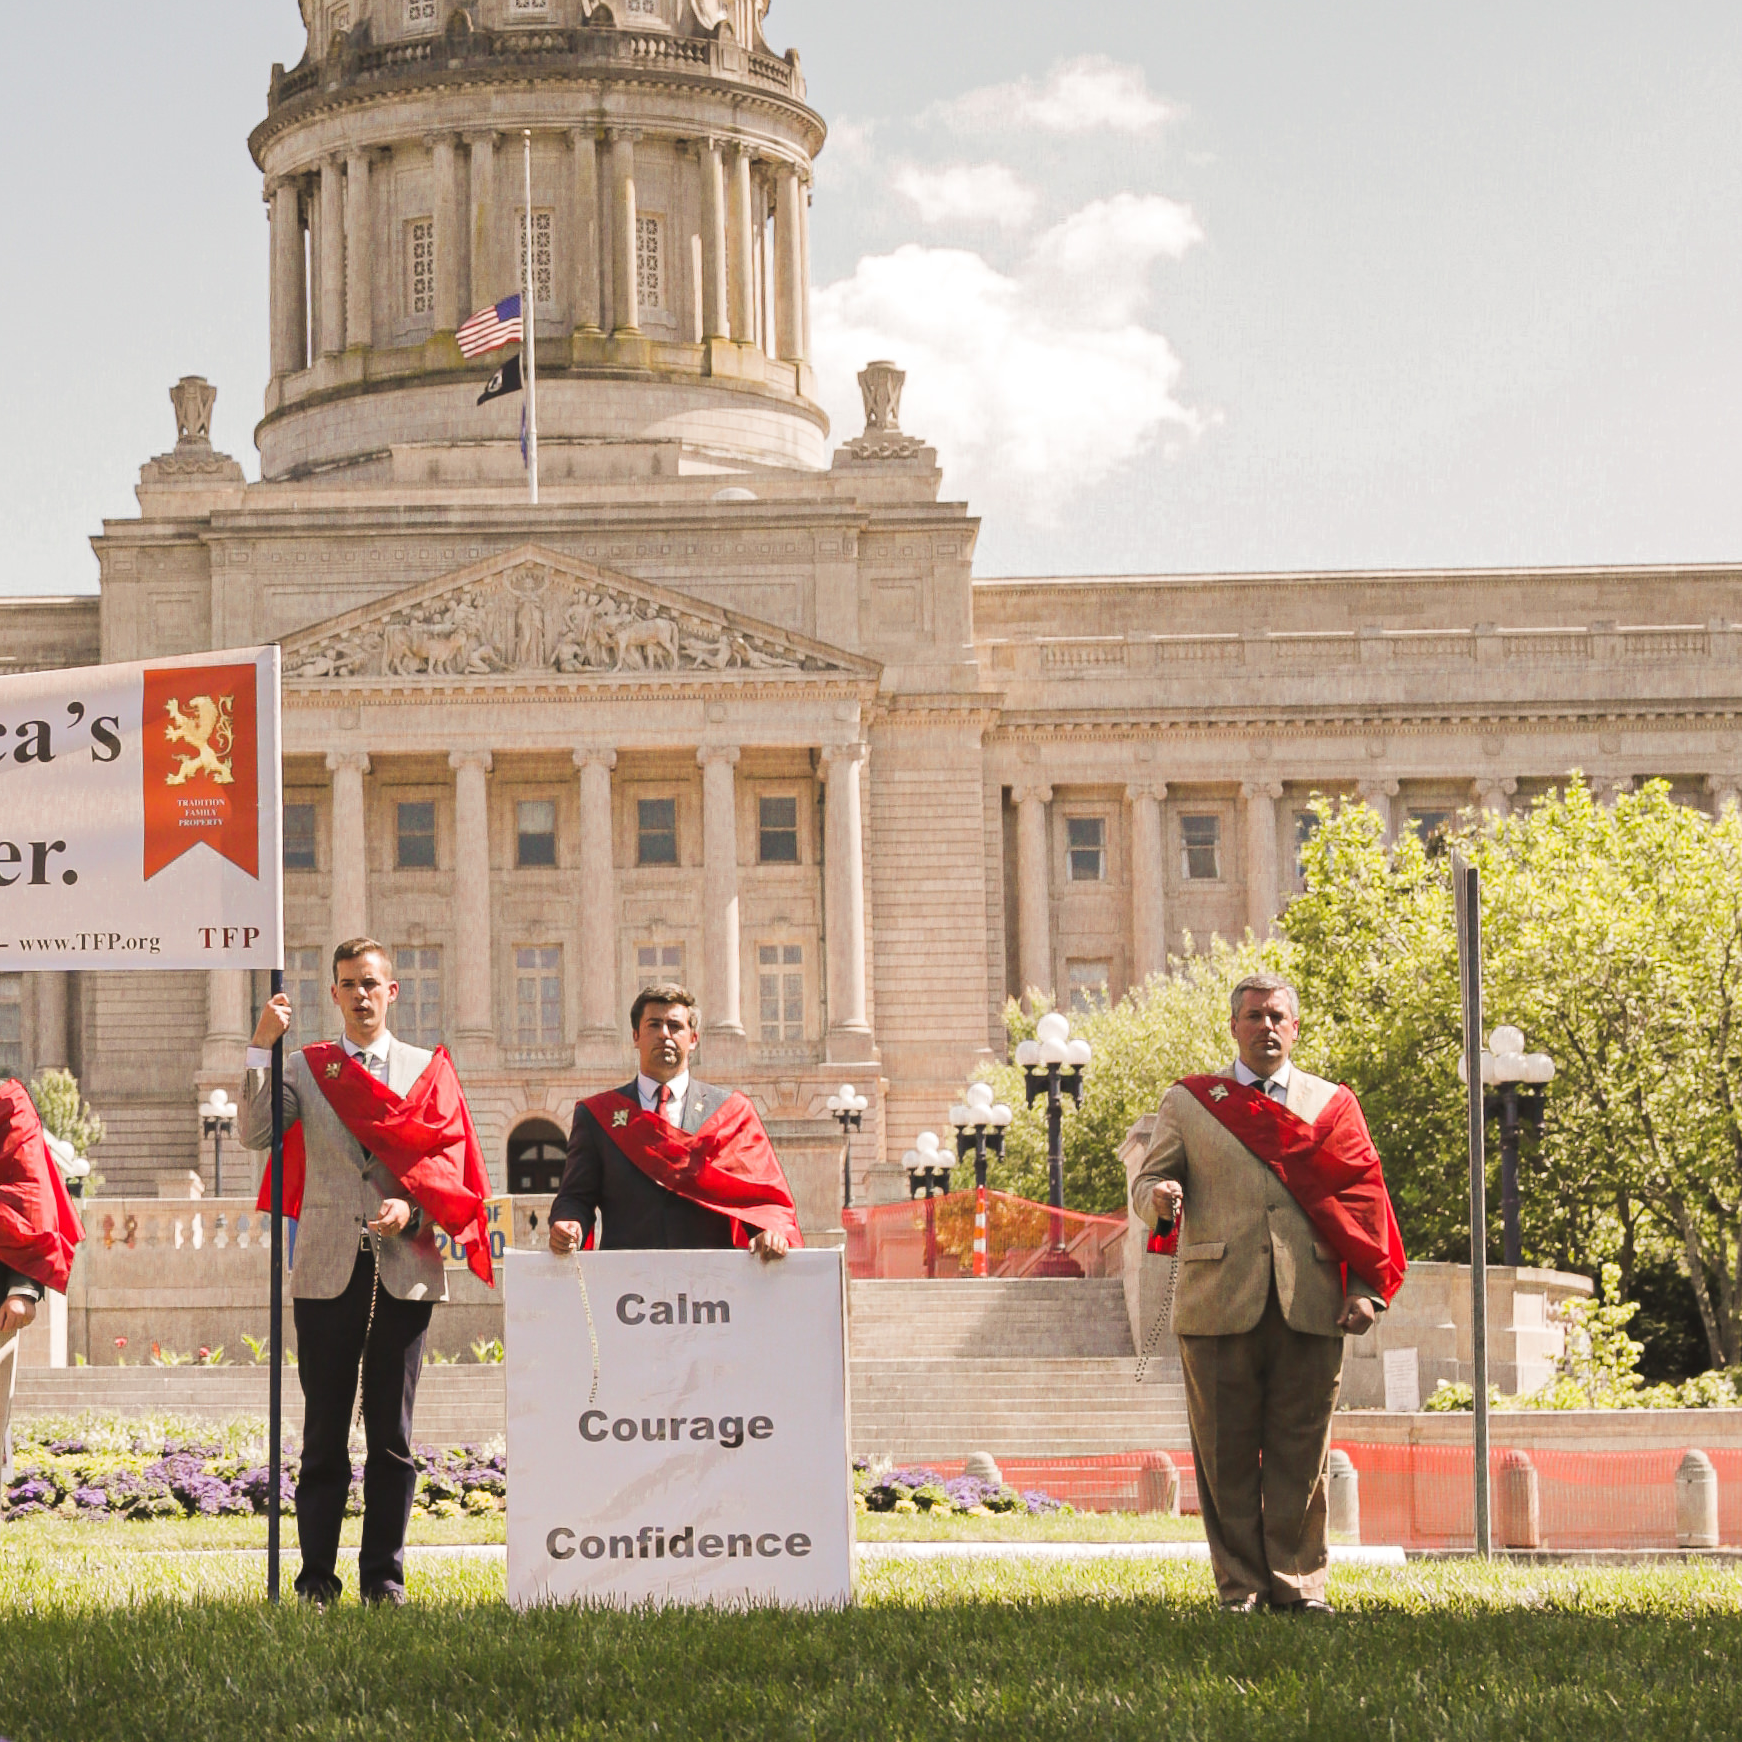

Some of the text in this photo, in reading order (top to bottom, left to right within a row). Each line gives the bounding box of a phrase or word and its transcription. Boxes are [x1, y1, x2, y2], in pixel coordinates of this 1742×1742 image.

[177, 798, 225, 807] TRADITION
[185, 808, 217, 817] FAMILY
[178, 818, 223, 827] PROPERTY
[19, 932, 161, 954] www.TFP.org
[198, 927, 261, 949] TFP
[435, 1231, 506, 1261] 200
[616, 1293, 730, 1325] Calm
[579, 1410, 773, 1448] Courage
[547, 1527, 811, 1559] Confidence
